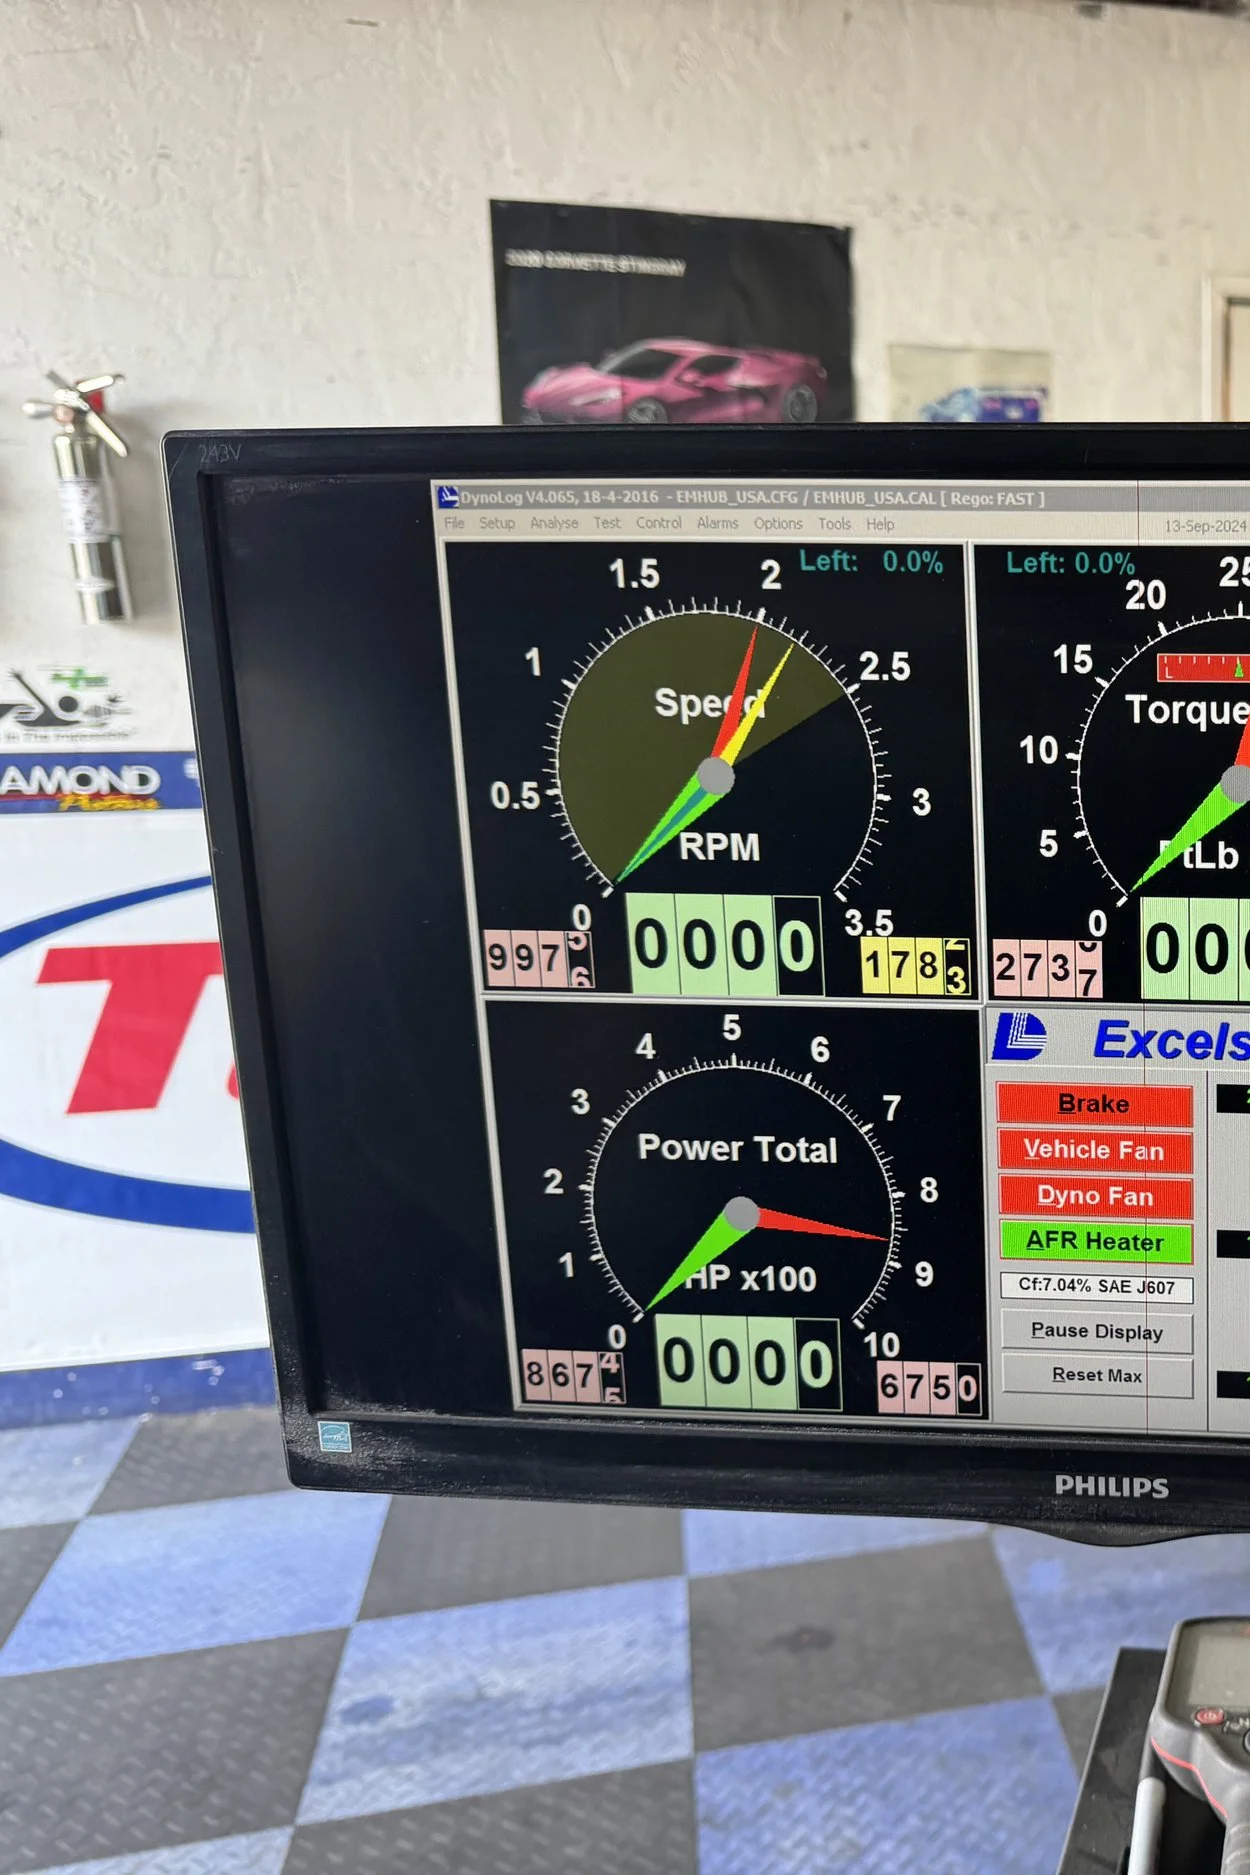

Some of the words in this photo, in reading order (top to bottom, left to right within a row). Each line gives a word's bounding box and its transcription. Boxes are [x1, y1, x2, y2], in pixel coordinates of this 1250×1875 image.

[461, 491, 523, 507] DynoLog
[526, 490, 579, 506] V4.065,
[583, 490, 659, 504] 18-4-2016
[676, 490, 798, 508] EMHUB_USA.CFG
[814, 491, 937, 508] EMHUB_USA.CAL
[951, 493, 994, 509] Rego:
[997, 493, 1035, 506] FAST
[444, 517, 465, 530] File
[480, 517, 515, 533] Setup
[531, 516, 579, 533] Analyse
[594, 516, 622, 530] Test
[636, 516, 683, 530] Control
[697, 516, 739, 530] Alarms
[754, 517, 804, 533] Options
[819, 517, 851, 531] Tools
[867, 518, 895, 534] Help
[1165, 519, 1248, 537] 13-Sep-2024
[609, 559, 660, 589] 1.5
[761, 560, 782, 590] 2
[800, 550, 859, 573] Left:
[883, 550, 944, 574] 0.0%
[1007, 552, 1066, 574] Left:
[1074, 552, 1136, 575] 0.0%
[1125, 579, 1166, 610] 20
[525, 647, 541, 676] 1
[859, 651, 911, 682] 2.5
[1053, 644, 1093, 675] 15
[655, 687, 766, 725] Sped
[1126, 694, 1250, 732] Torque
[1020, 735, 1058, 764] 10
[490, 781, 541, 810] 0.5
[912, 788, 932, 816] 3
[680, 833, 760, 862] RPM
[1039, 829, 1058, 857] 5
[845, 909, 894, 937] 3.5
[634, 918, 815, 972] 0000
[722, 1014, 741, 1041] 5
[571, 1089, 590, 1115] 3
[882, 1095, 901, 1122] 7
[1058, 1093, 1130, 1114] Brake
[638, 1133, 743, 1161] Power
[753, 1136, 837, 1164] Total
[1024, 1138, 1110, 1160] Vehicle
[1119, 1141, 1165, 1161] Fan
[544, 1169, 564, 1194] 2
[920, 1177, 939, 1203] 8
[1037, 1184, 1101, 1209] Dyno
[1109, 1187, 1154, 1207] Fan
[1026, 1230, 1078, 1251] AFR
[1086, 1231, 1165, 1253] Heater
[685, 1265, 730, 1290] HP
[741, 1266, 817, 1292] x100
[1019, 1277, 1092, 1294] Cf:7.04%
[1098, 1279, 1132, 1295] SAE
[1136, 1280, 1175, 1296] J607
[864, 1332, 900, 1358] 10
[1031, 1322, 1089, 1339] Pause
[1095, 1324, 1164, 1343] Display
[663, 1336, 833, 1389] 0000
[1053, 1368, 1103, 1383] Reset
[1108, 1369, 1143, 1384] Max
[880, 1372, 977, 1402] 6750
[1056, 1475, 1169, 1498] PHILIPS
